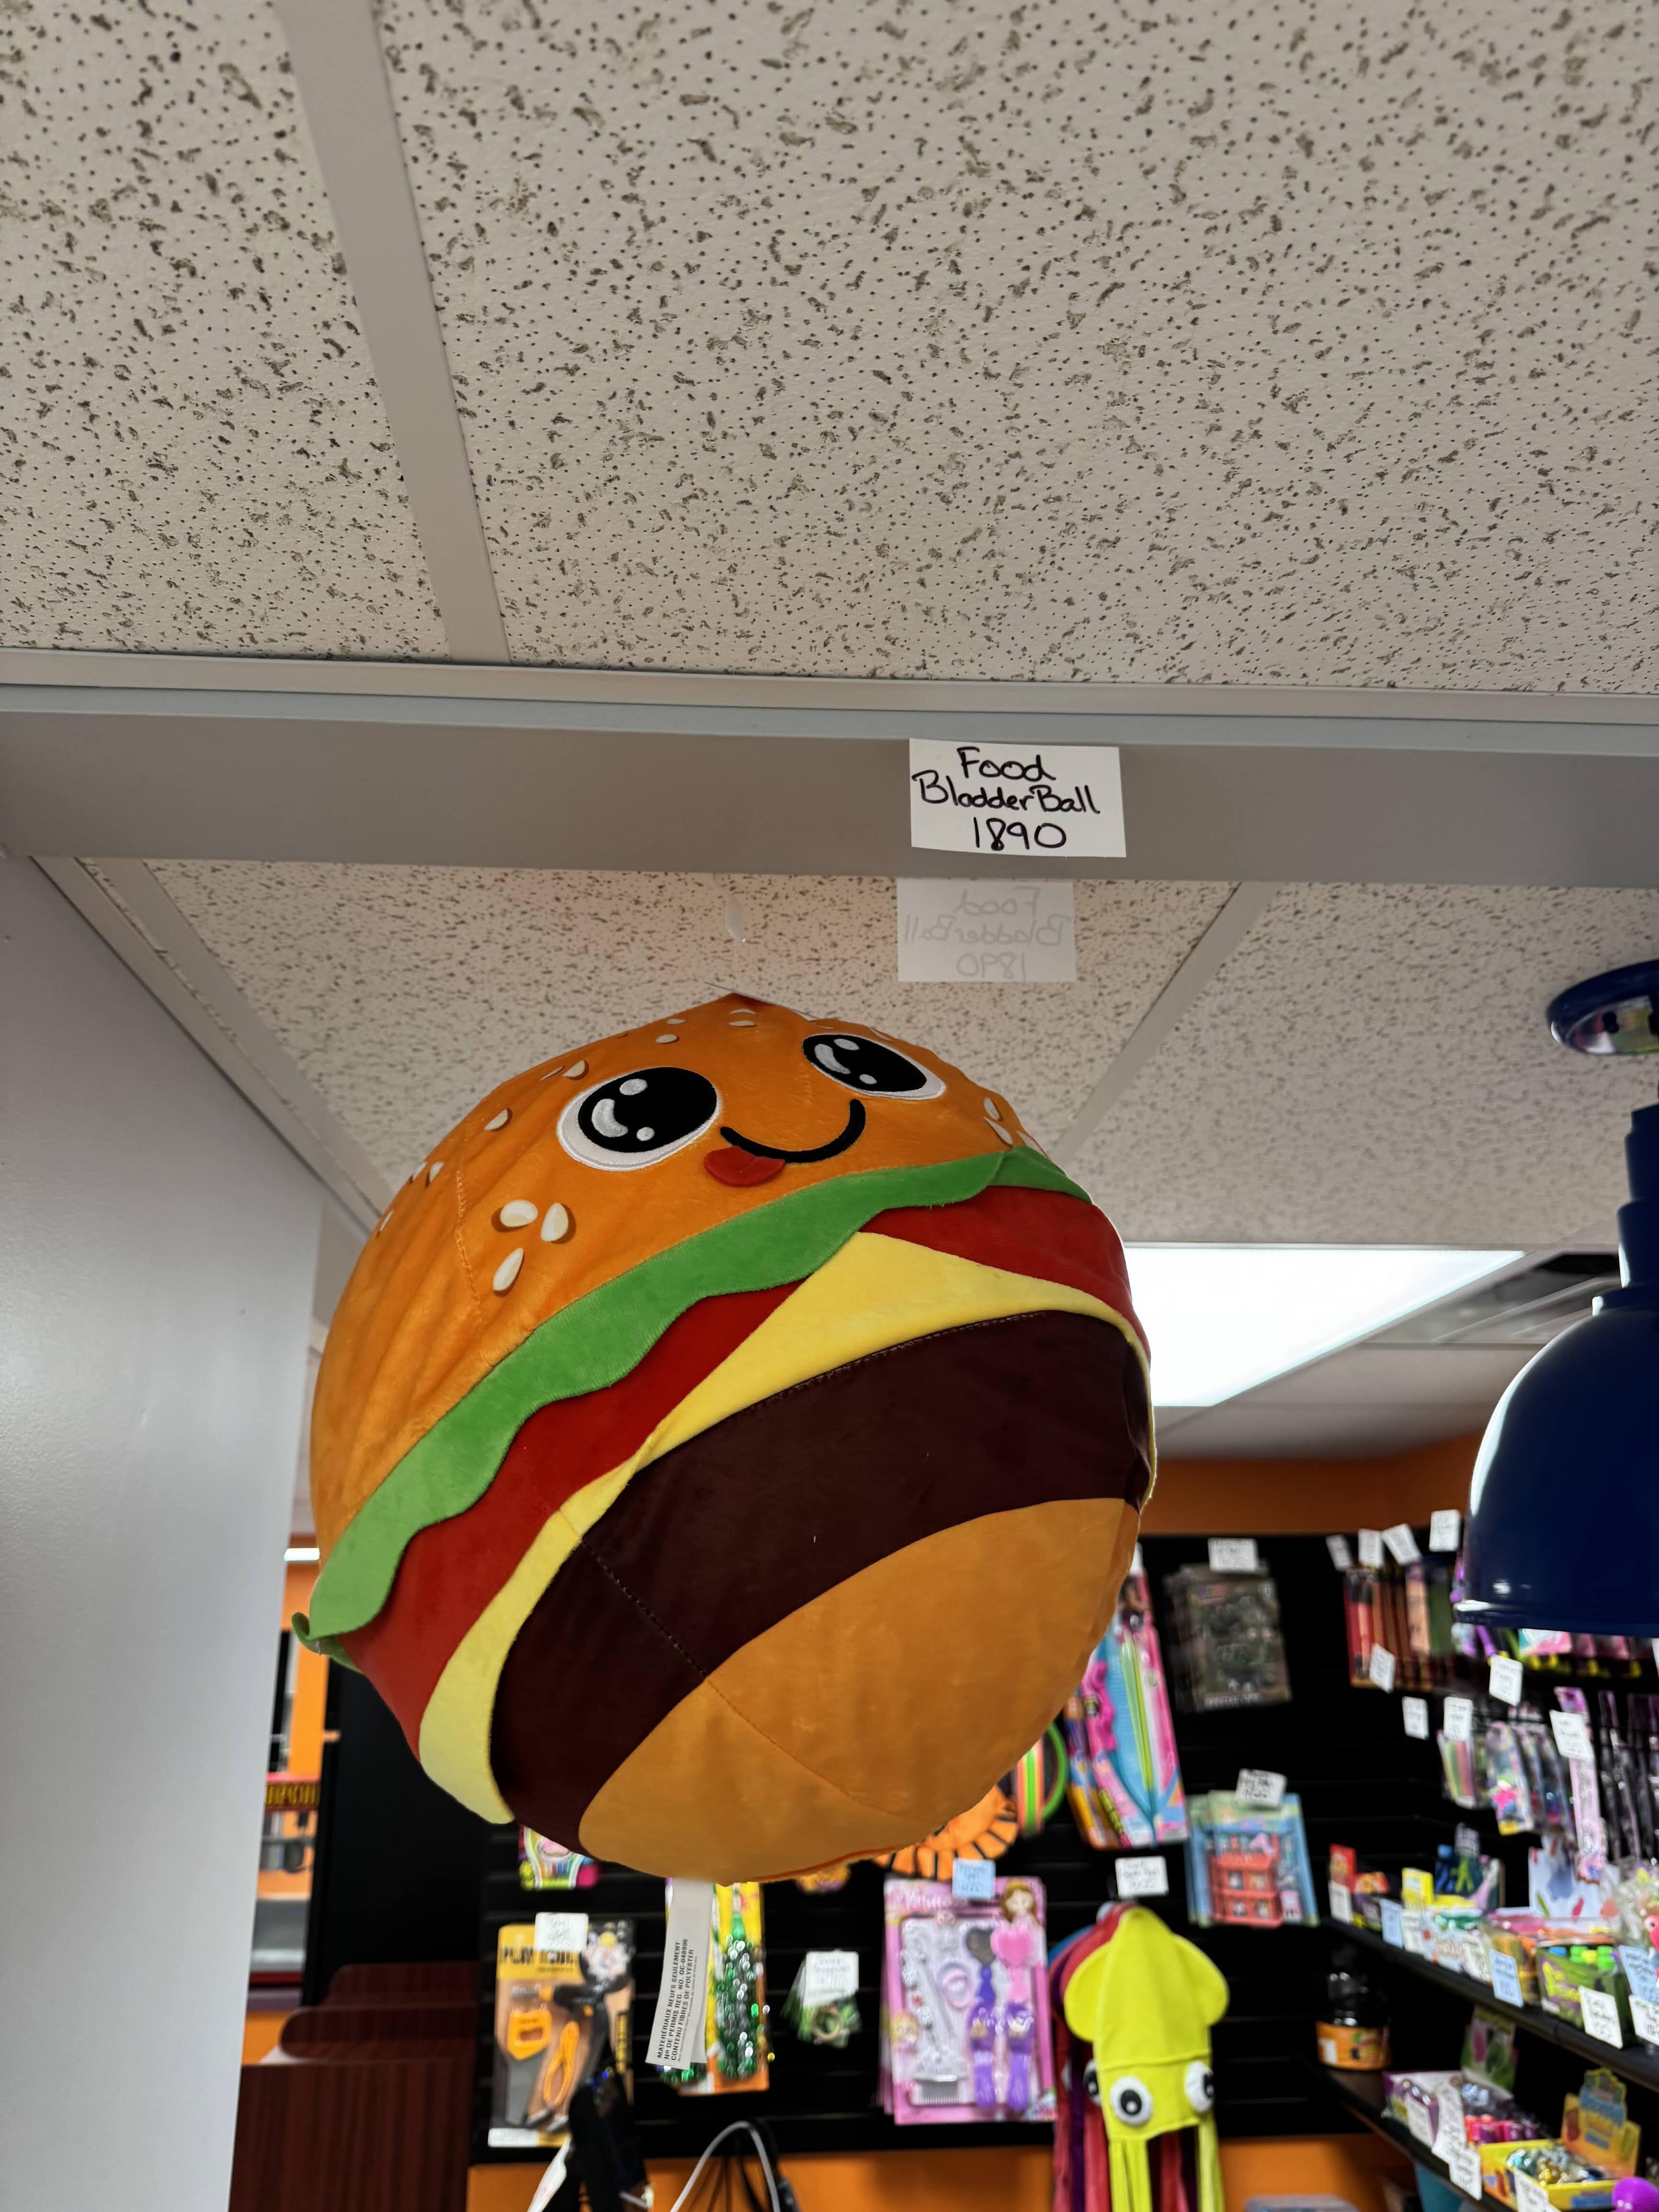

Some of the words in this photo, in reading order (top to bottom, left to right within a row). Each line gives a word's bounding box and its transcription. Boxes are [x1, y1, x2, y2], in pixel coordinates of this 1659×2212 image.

[956, 746, 1057, 782] Food
[973, 816, 1067, 851] 1890
[671, 1942, 681, 1982] SEULEMENT
[685, 1949, 694, 1988] POLYESTER
[683, 1990, 690, 1999] DE
[678, 2001, 688, 2025] FIBRES
[666, 2039, 673, 2048] DE
[671, 2027, 682, 2060] CONTENU
